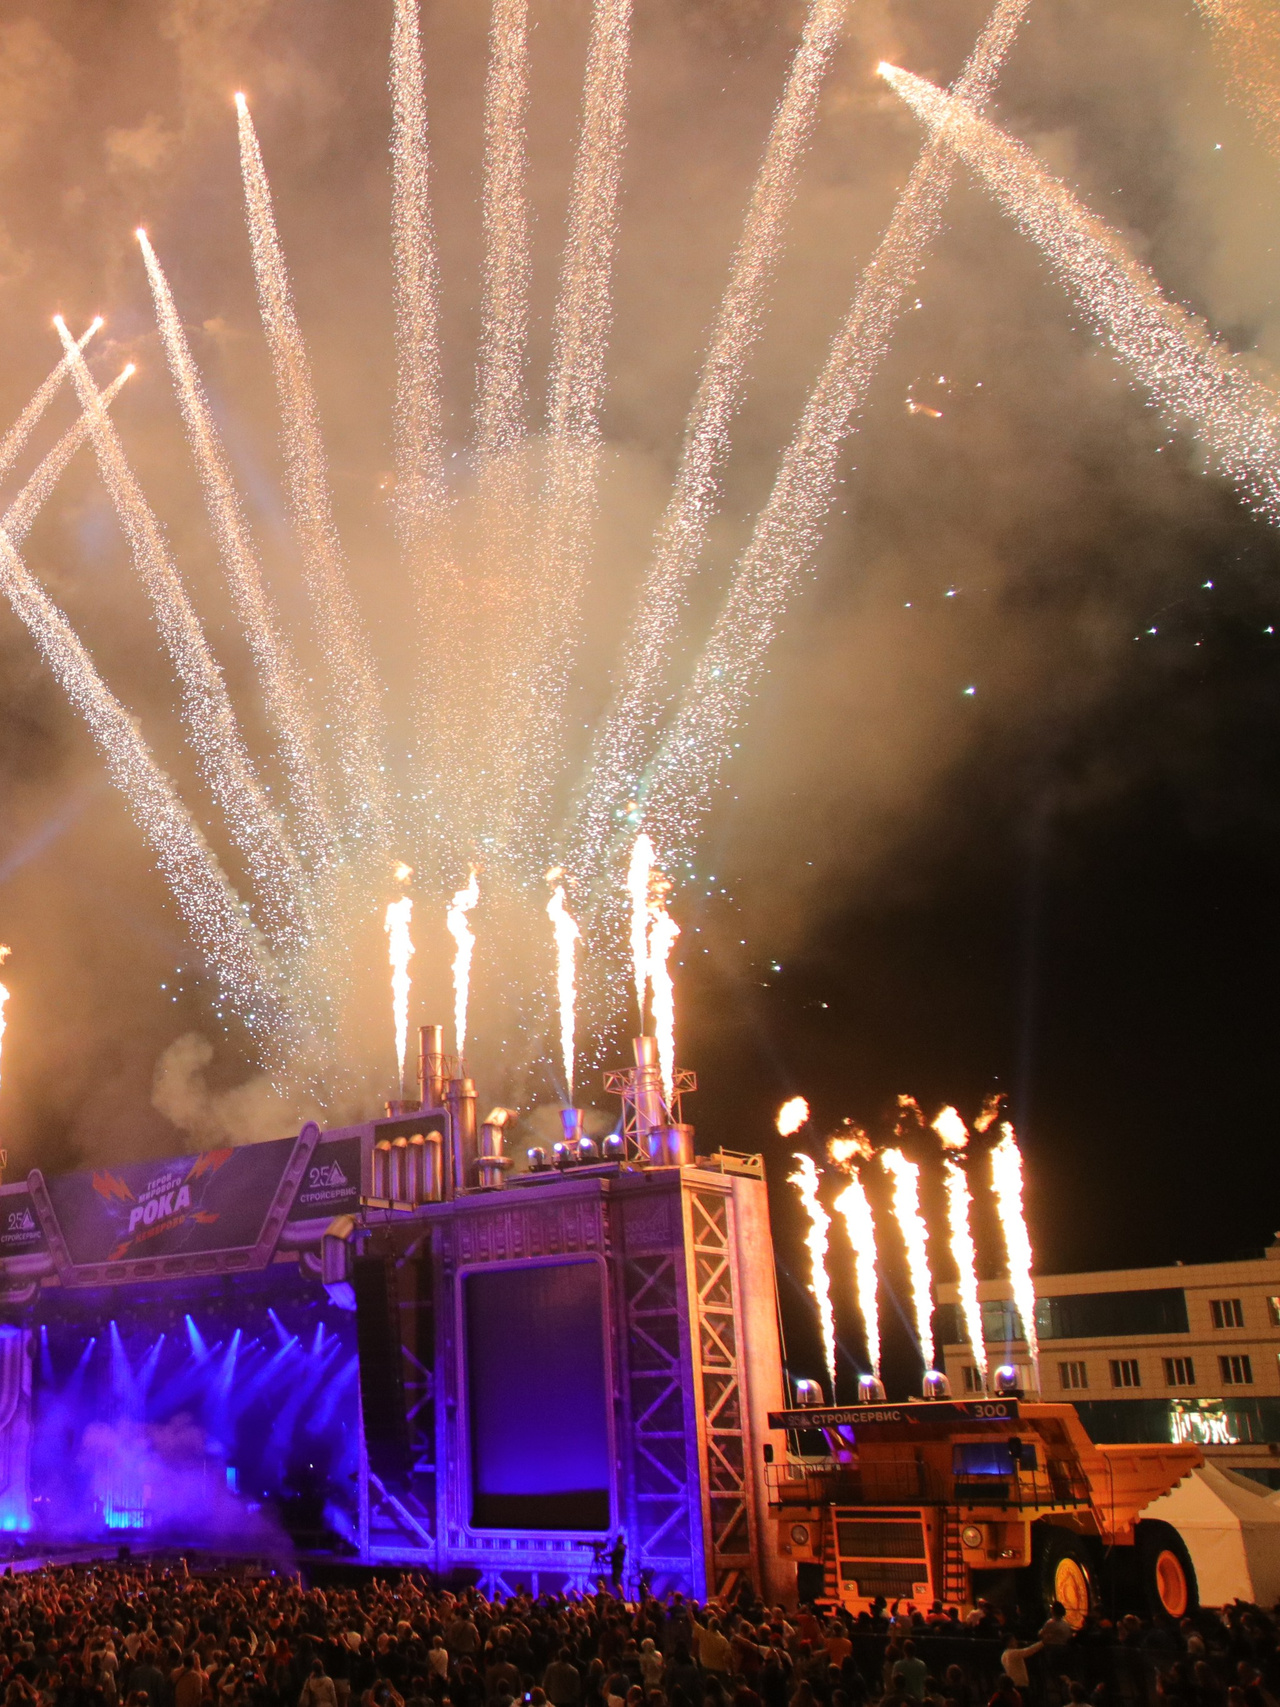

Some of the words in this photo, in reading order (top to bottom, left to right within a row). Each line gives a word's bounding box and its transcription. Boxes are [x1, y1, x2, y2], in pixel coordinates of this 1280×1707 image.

[138, 1177, 182, 1203] МИРОВОГО
[300, 1186, 357, 1202] СТРОЙСЕРВИС
[129, 1184, 191, 1232] РОКА
[0, 1231, 41, 1242] СТРОЙСЕРВИС
[811, 1410, 901, 1425] СТРОЙСЕРВИС
[974, 1404, 1008, 1418] 300
